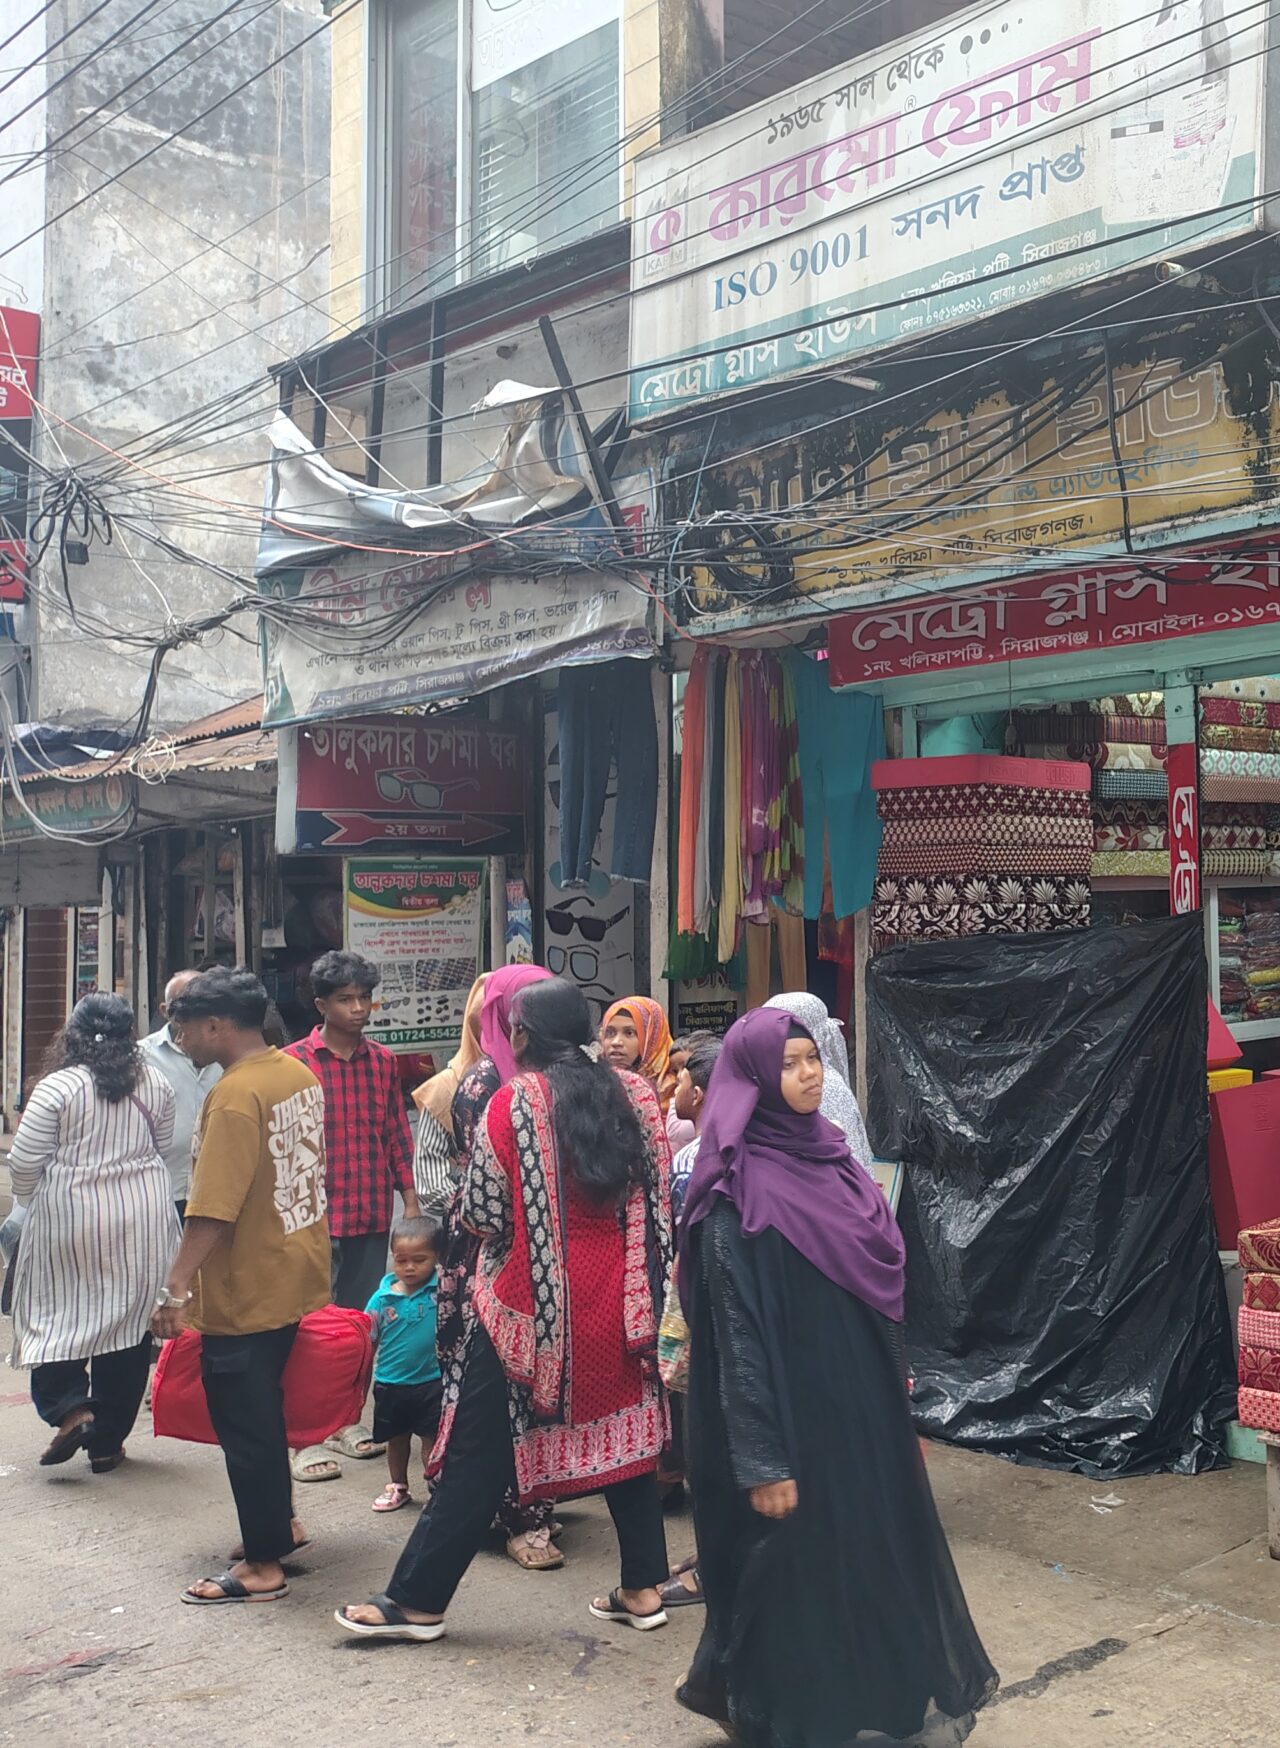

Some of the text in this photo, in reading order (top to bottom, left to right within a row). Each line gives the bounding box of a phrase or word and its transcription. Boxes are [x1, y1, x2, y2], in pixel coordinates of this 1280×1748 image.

[835, 73, 878, 111] সাল
[886, 43, 945, 92] থেকে
[709, 110, 902, 241] কারমো
[922, 26, 1102, 159] ফোম
[891, 143, 1086, 240] সনদ প্রাপ্ত
[712, 223, 870, 313] ISO 9001
[724, 337, 780, 383] গ্লাস
[852, 587, 1018, 651] মেট্রো
[1041, 566, 1170, 628] গ্লাস
[863, 660, 894, 677] ১নং
[1000, 629, 1089, 656] সিরাজগঞ্জ
[310, 719, 417, 775] তালুকদার
[424, 725, 481, 768] চশমা
[413, 823, 449, 836] তলা
[353, 872, 417, 893] তালুকদার
